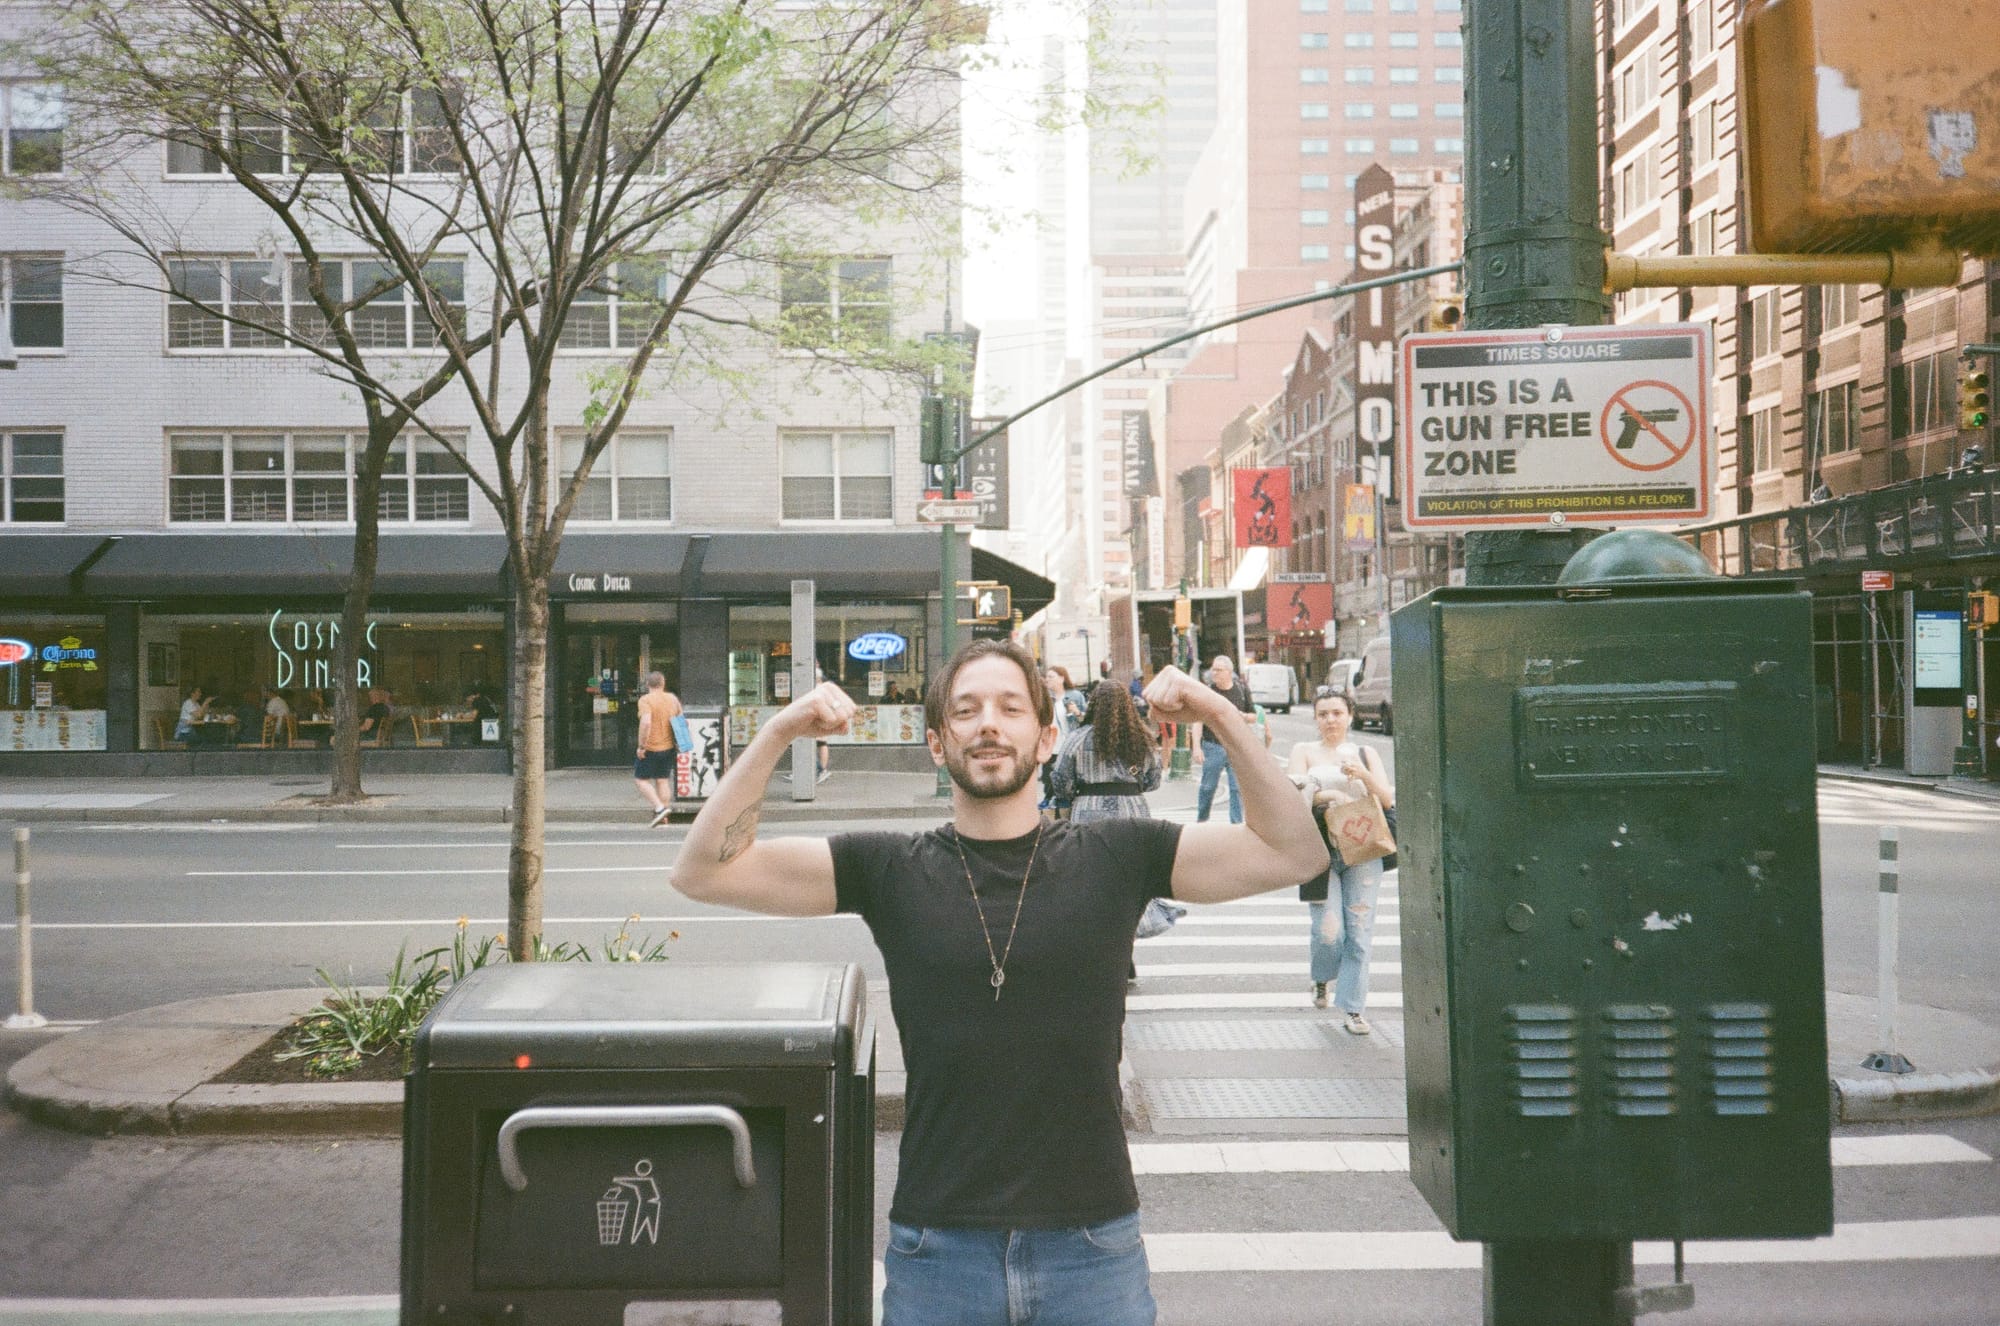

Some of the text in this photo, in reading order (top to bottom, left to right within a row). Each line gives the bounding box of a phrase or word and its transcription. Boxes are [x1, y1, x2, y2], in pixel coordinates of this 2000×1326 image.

[1359, 190, 1392, 217] NEIL
[1359, 224, 1393, 498] SIMON
[1485, 343, 1621, 363] TIMES SQUARE
[1420, 377, 1574, 408] THIS IS A
[1420, 411, 1592, 443] GUN FREE
[1424, 450, 1517, 477] ZONE
[1427, 500, 1486, 511] VIOLATION
[1490, 499, 1505, 509] OF
[1508, 498, 1533, 509] THIS
[1536, 496, 1611, 508] PROHIBITION
[1614, 495, 1625, 506] IS
[1628, 495, 1637, 505] A
[568, 573, 597, 592] COSMIC
[269, 609, 377, 650] COSC
[42, 645, 96, 662] Corona
[853, 637, 898, 656] OPEN
[278, 650, 371, 689] DINR
[676, 755, 690, 796] CHIC
